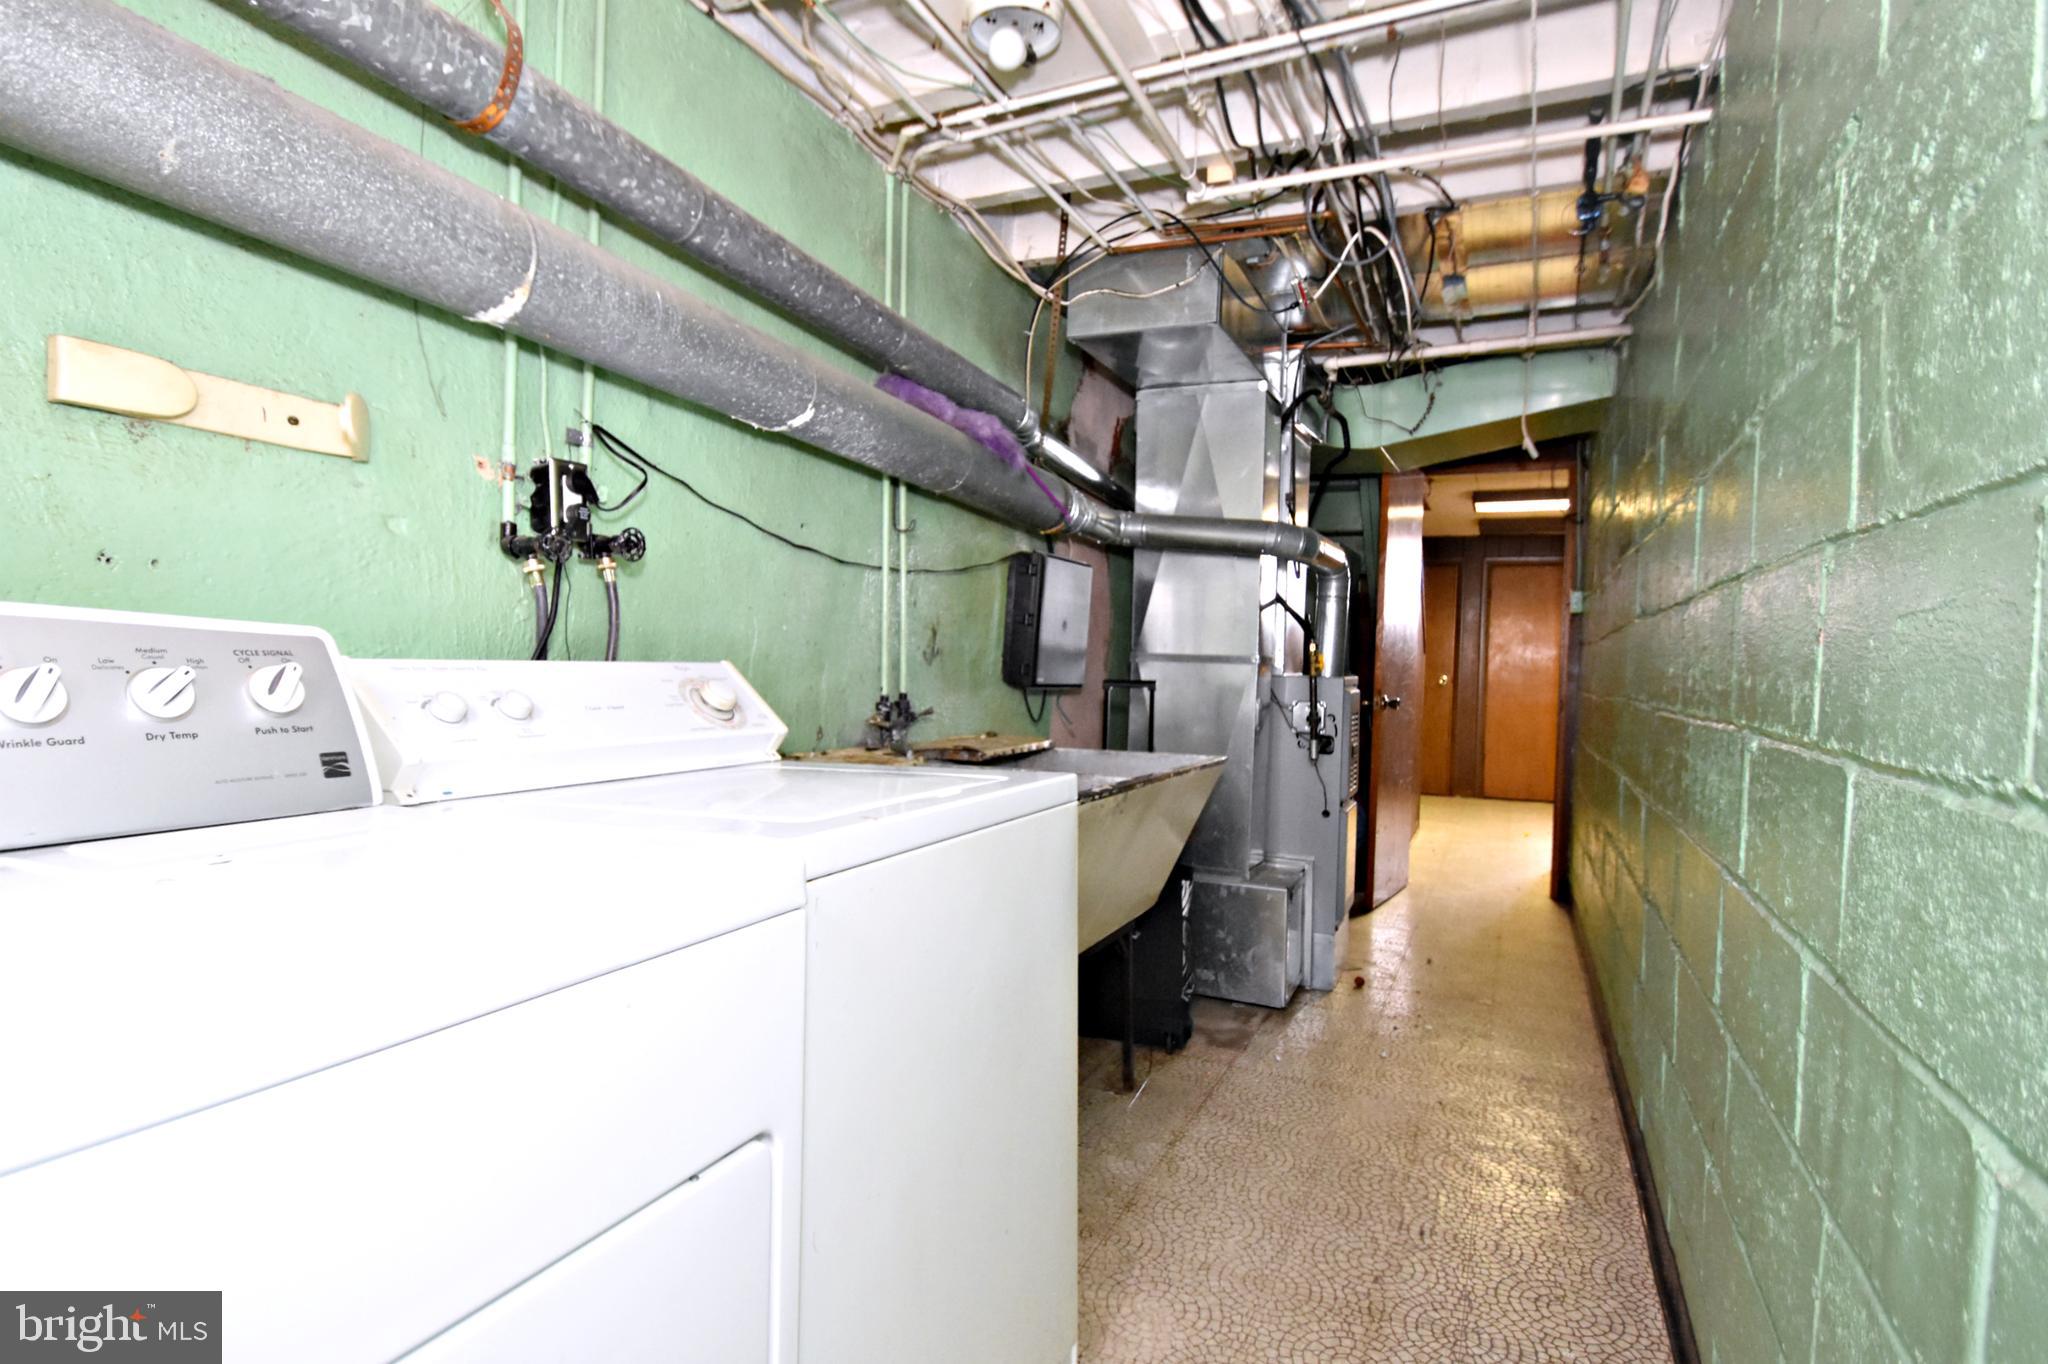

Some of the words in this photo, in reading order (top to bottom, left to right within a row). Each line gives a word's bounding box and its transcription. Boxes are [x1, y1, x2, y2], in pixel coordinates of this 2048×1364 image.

[186, 657, 205, 665] High
[255, 727, 278, 735] Push
[291, 725, 313, 733] Start
[145, 732, 166, 741] Dry
[169, 731, 199, 740] Temp
[46, 736, 86, 747] Guard
